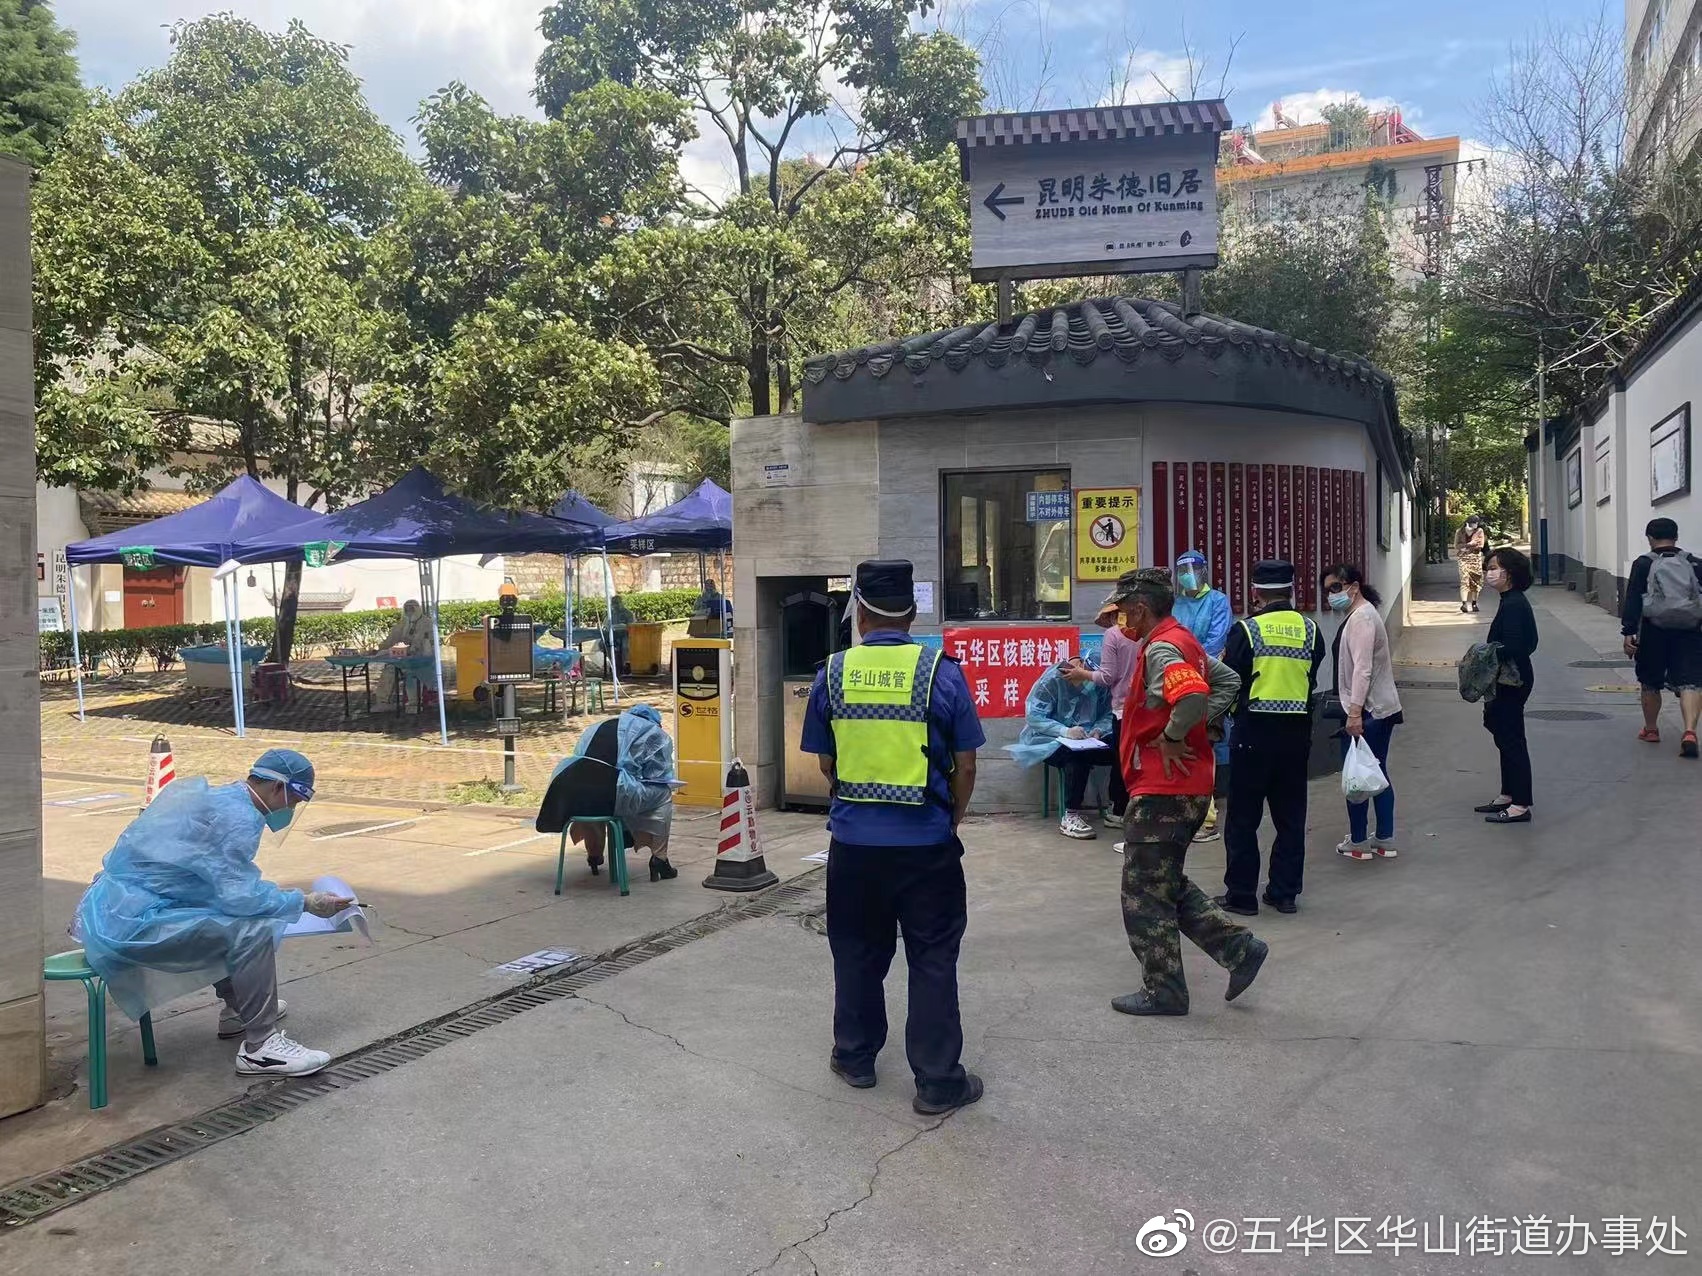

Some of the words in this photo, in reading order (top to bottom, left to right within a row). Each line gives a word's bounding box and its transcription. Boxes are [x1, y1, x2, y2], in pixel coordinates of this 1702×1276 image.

[1037, 168, 1203, 206] 昆明朱德旧居
[1035, 207, 1075, 219] ZHUDE
[1078, 205, 1098, 217] Old
[1102, 203, 1133, 216] Home
[1137, 202, 1151, 213] Of
[1154, 200, 1203, 212] Kunming
[1081, 495, 1134, 510] 重要提示
[1039, 506, 1070, 518] 不对外停车
[630, 538, 655, 550] 采样区
[124, 552, 152, 567] 登记区
[1264, 623, 1302, 638] 华山城管
[954, 638, 1071, 667] 五华区核酸检测
[849, 668, 907, 688] 华山城管
[974, 678, 1020, 707] 采样
